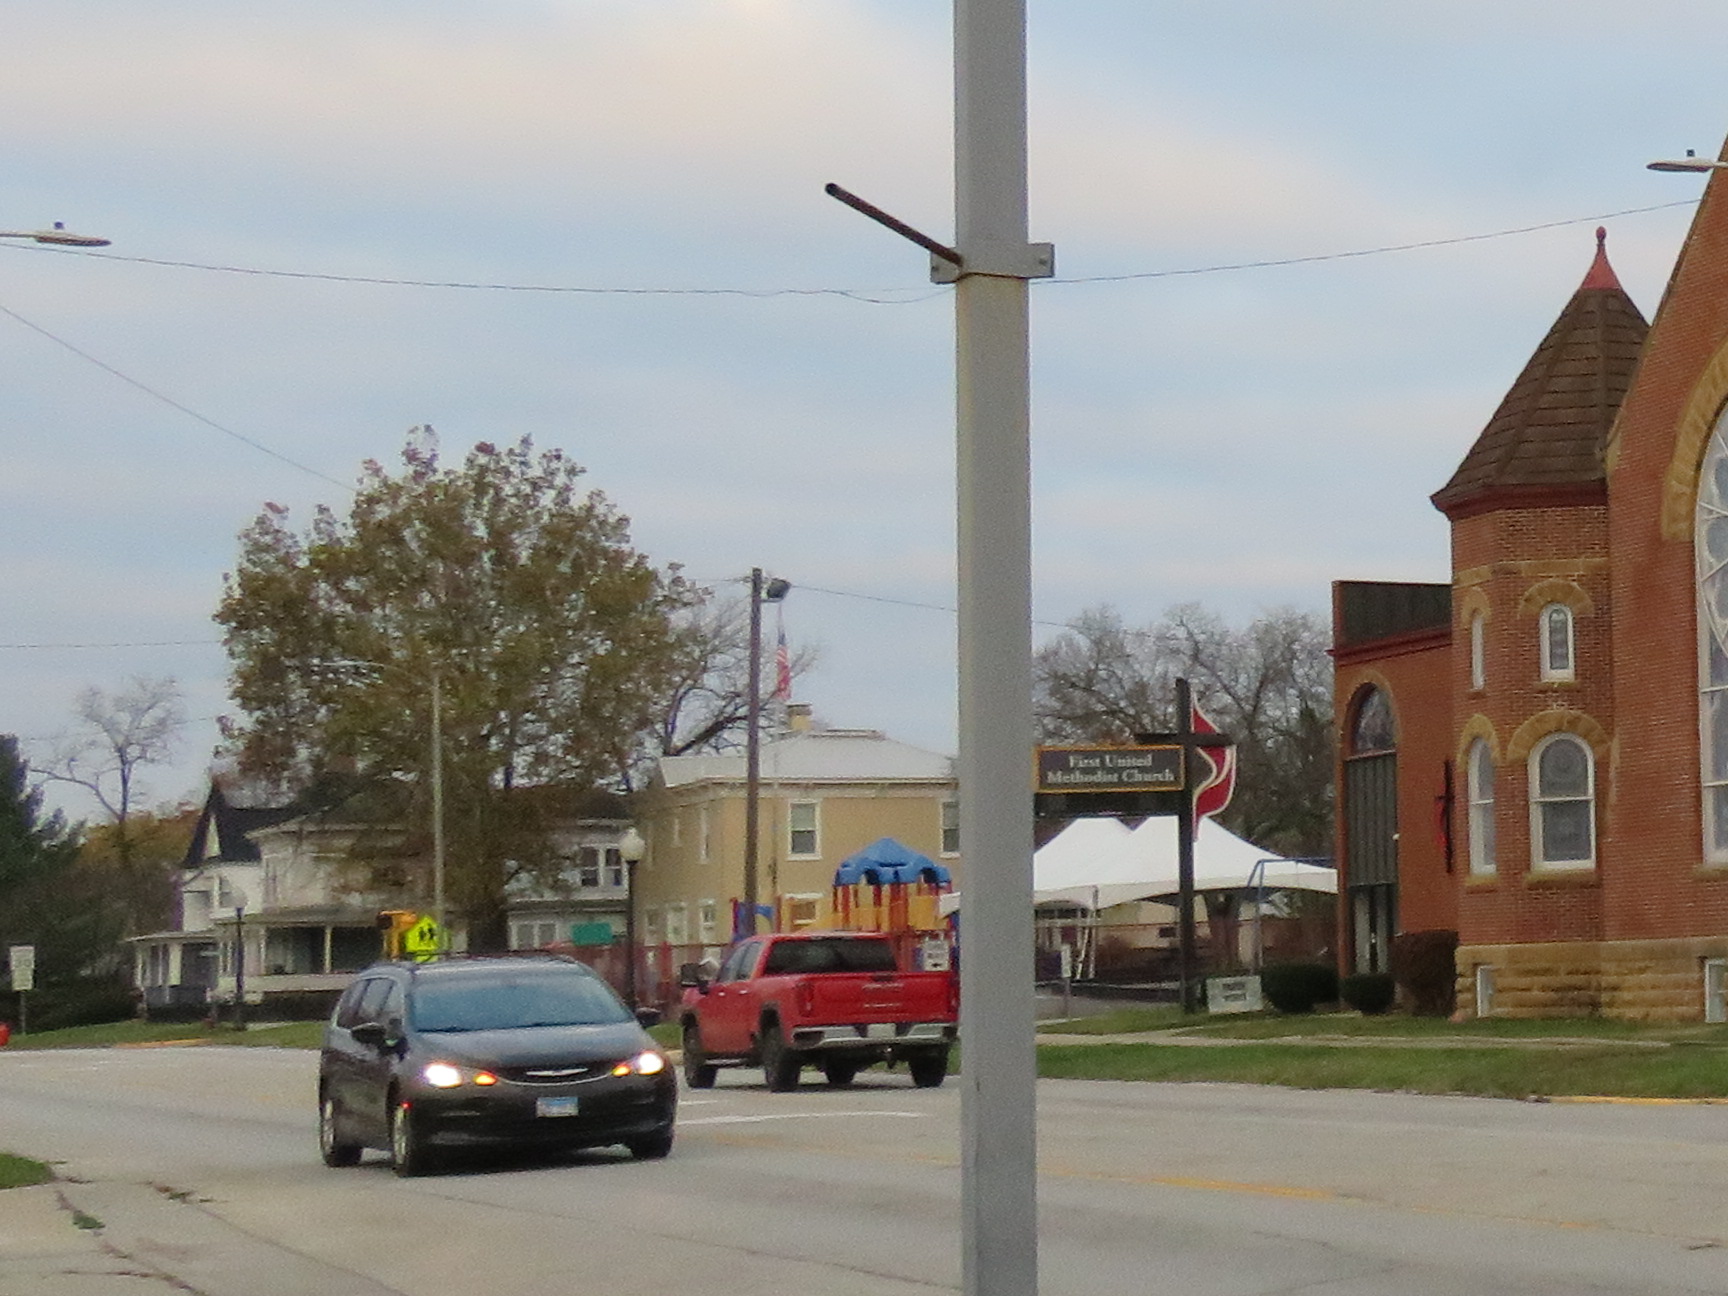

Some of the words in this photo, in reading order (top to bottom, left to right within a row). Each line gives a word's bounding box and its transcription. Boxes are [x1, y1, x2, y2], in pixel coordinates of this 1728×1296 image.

[1069, 755, 1100, 768] First
[1105, 753, 1153, 767] United
[1046, 770, 1119, 783] Methodist
[1121, 768, 1175, 782] Church
